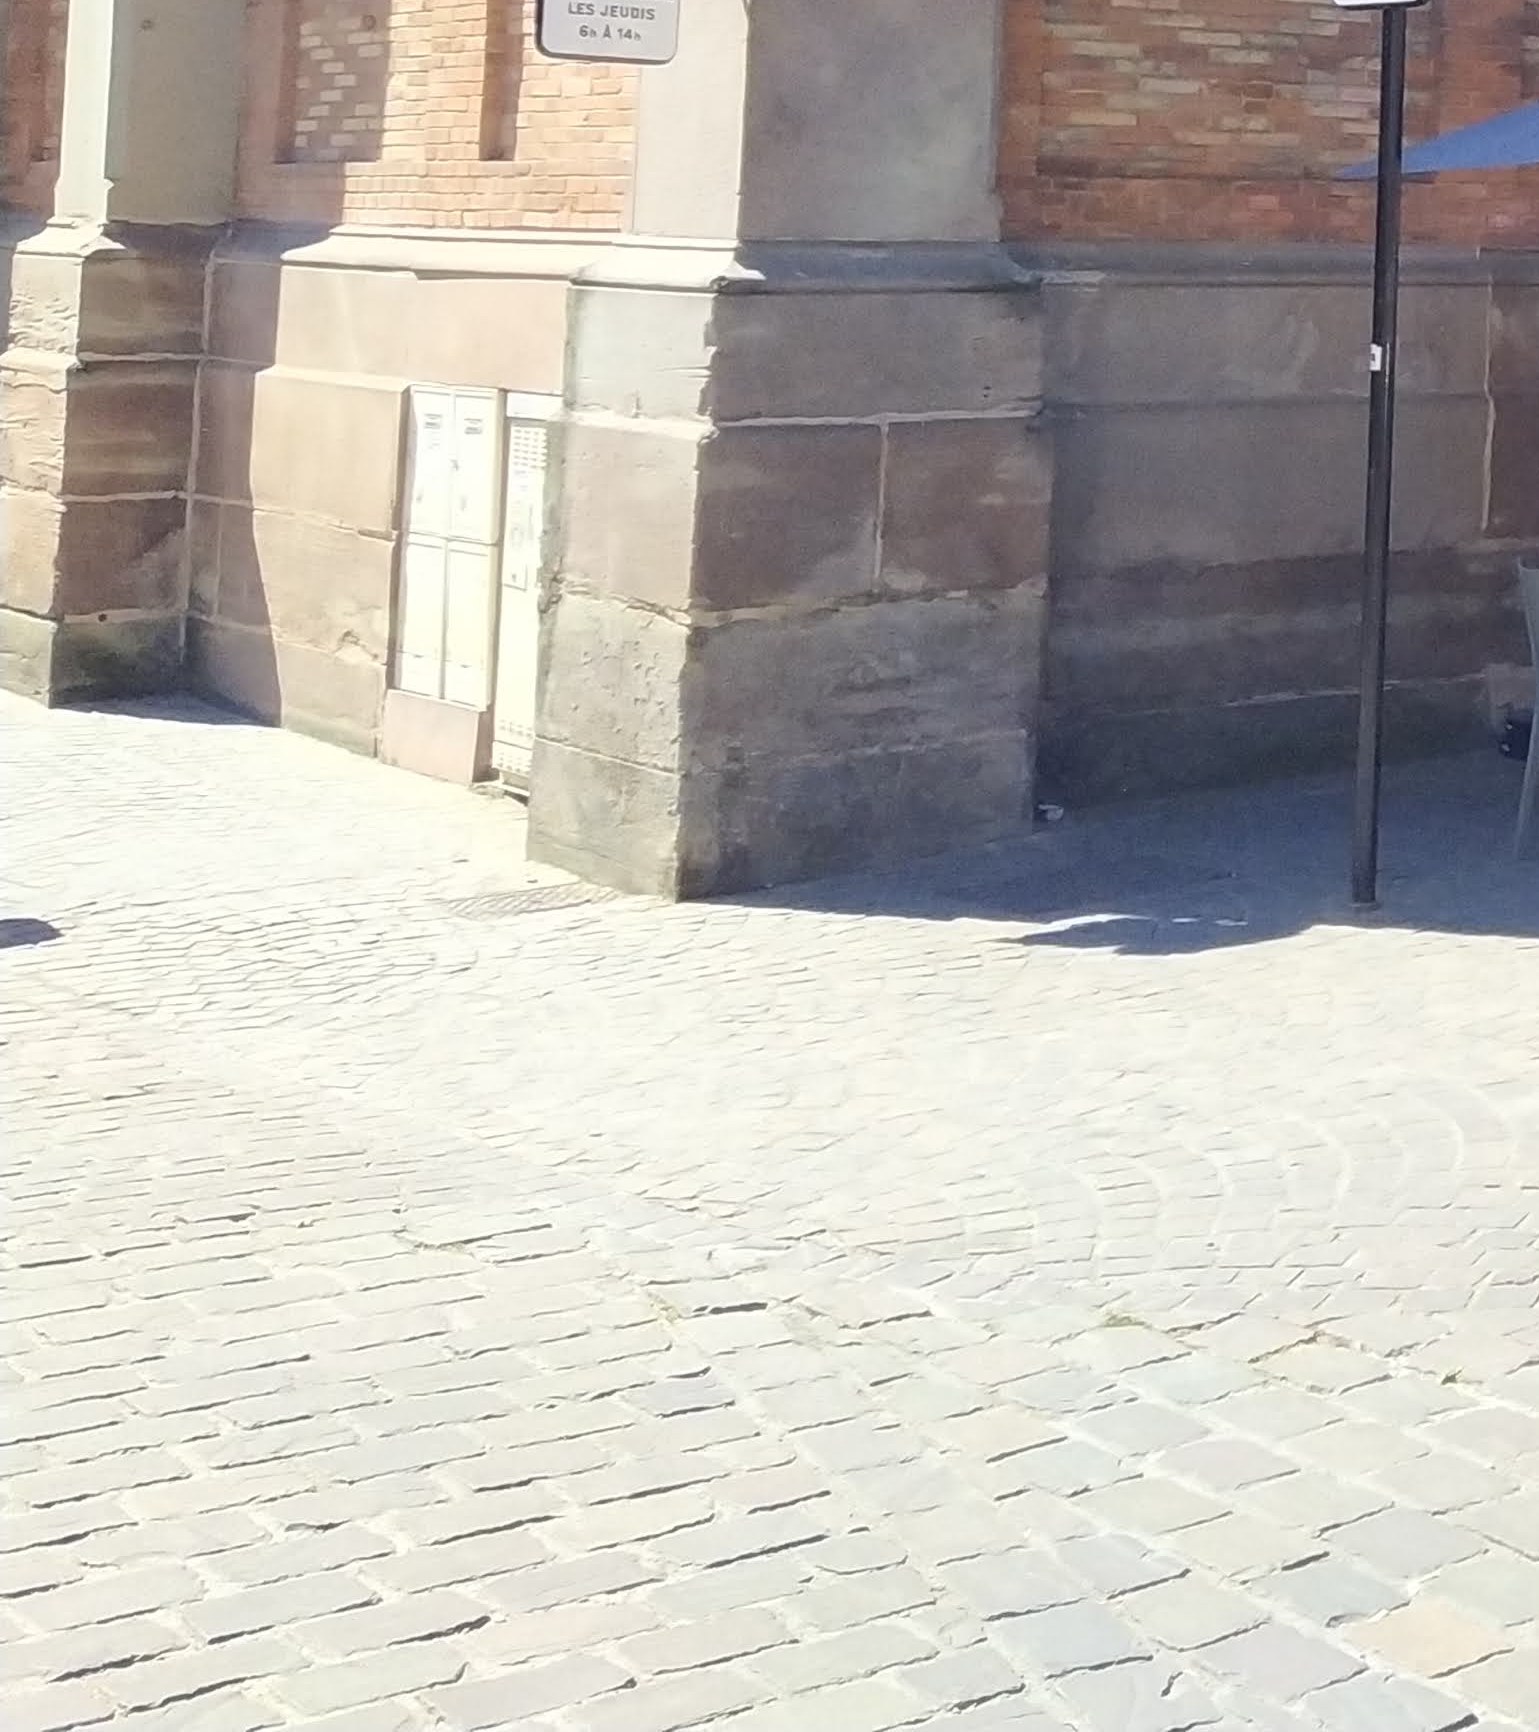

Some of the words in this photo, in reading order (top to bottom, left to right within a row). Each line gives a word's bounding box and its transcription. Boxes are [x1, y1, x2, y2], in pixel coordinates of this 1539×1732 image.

[567, 1, 596, 16] LES
[600, 5, 656, 21] JEUDIS
[578, 24, 597, 39] 6h
[602, 24, 612, 39] À
[617, 28, 642, 42] 14h
